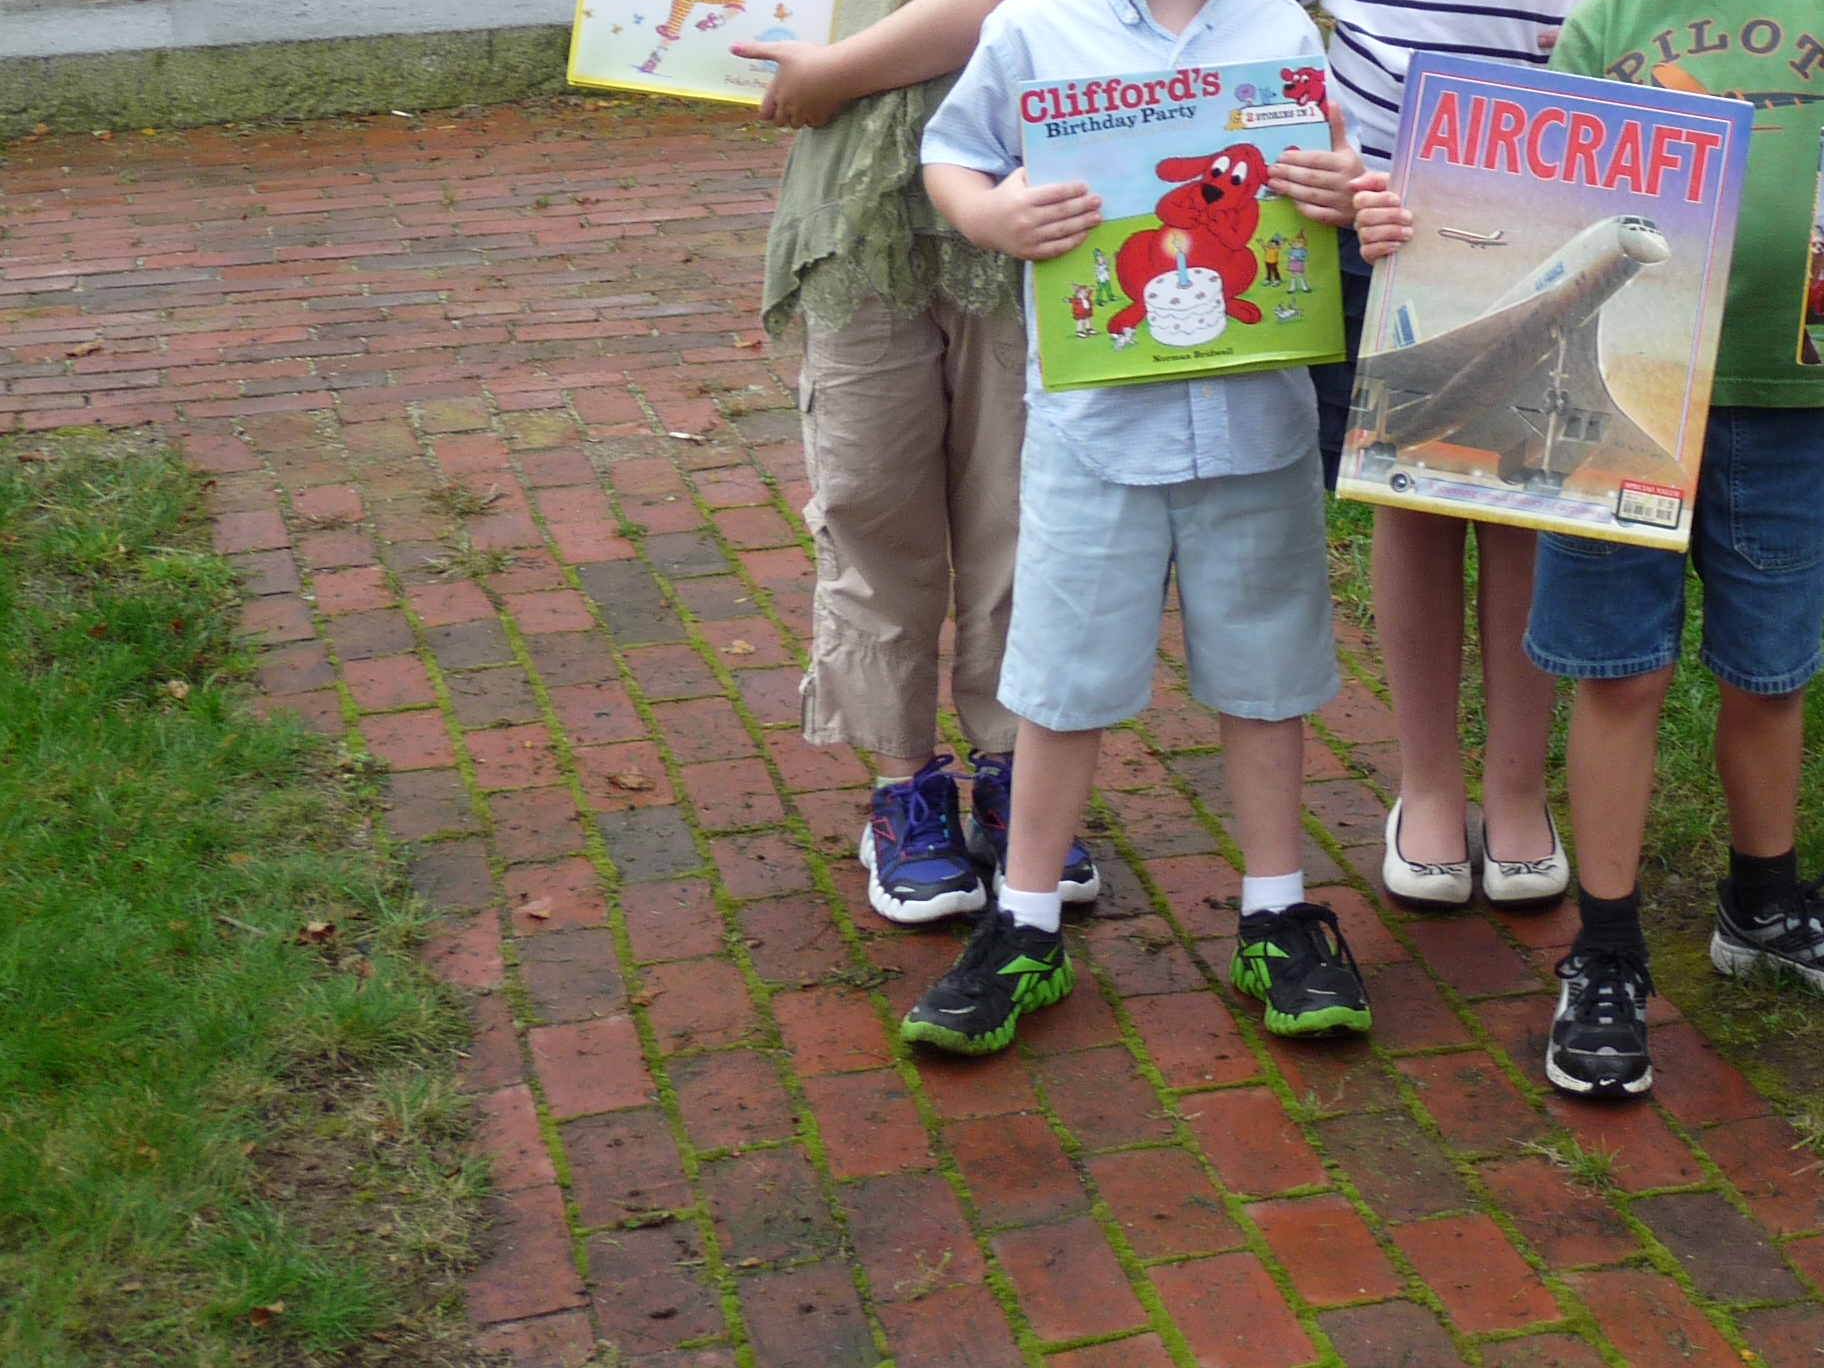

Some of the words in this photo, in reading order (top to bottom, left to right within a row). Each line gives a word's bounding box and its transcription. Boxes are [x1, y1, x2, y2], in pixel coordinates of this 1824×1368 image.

[1020, 67, 1222, 124] Clifford's
[1045, 114, 1137, 138] Birthday
[1140, 105, 1197, 123] Party
[1418, 90, 1724, 204] AIRCRAFT
